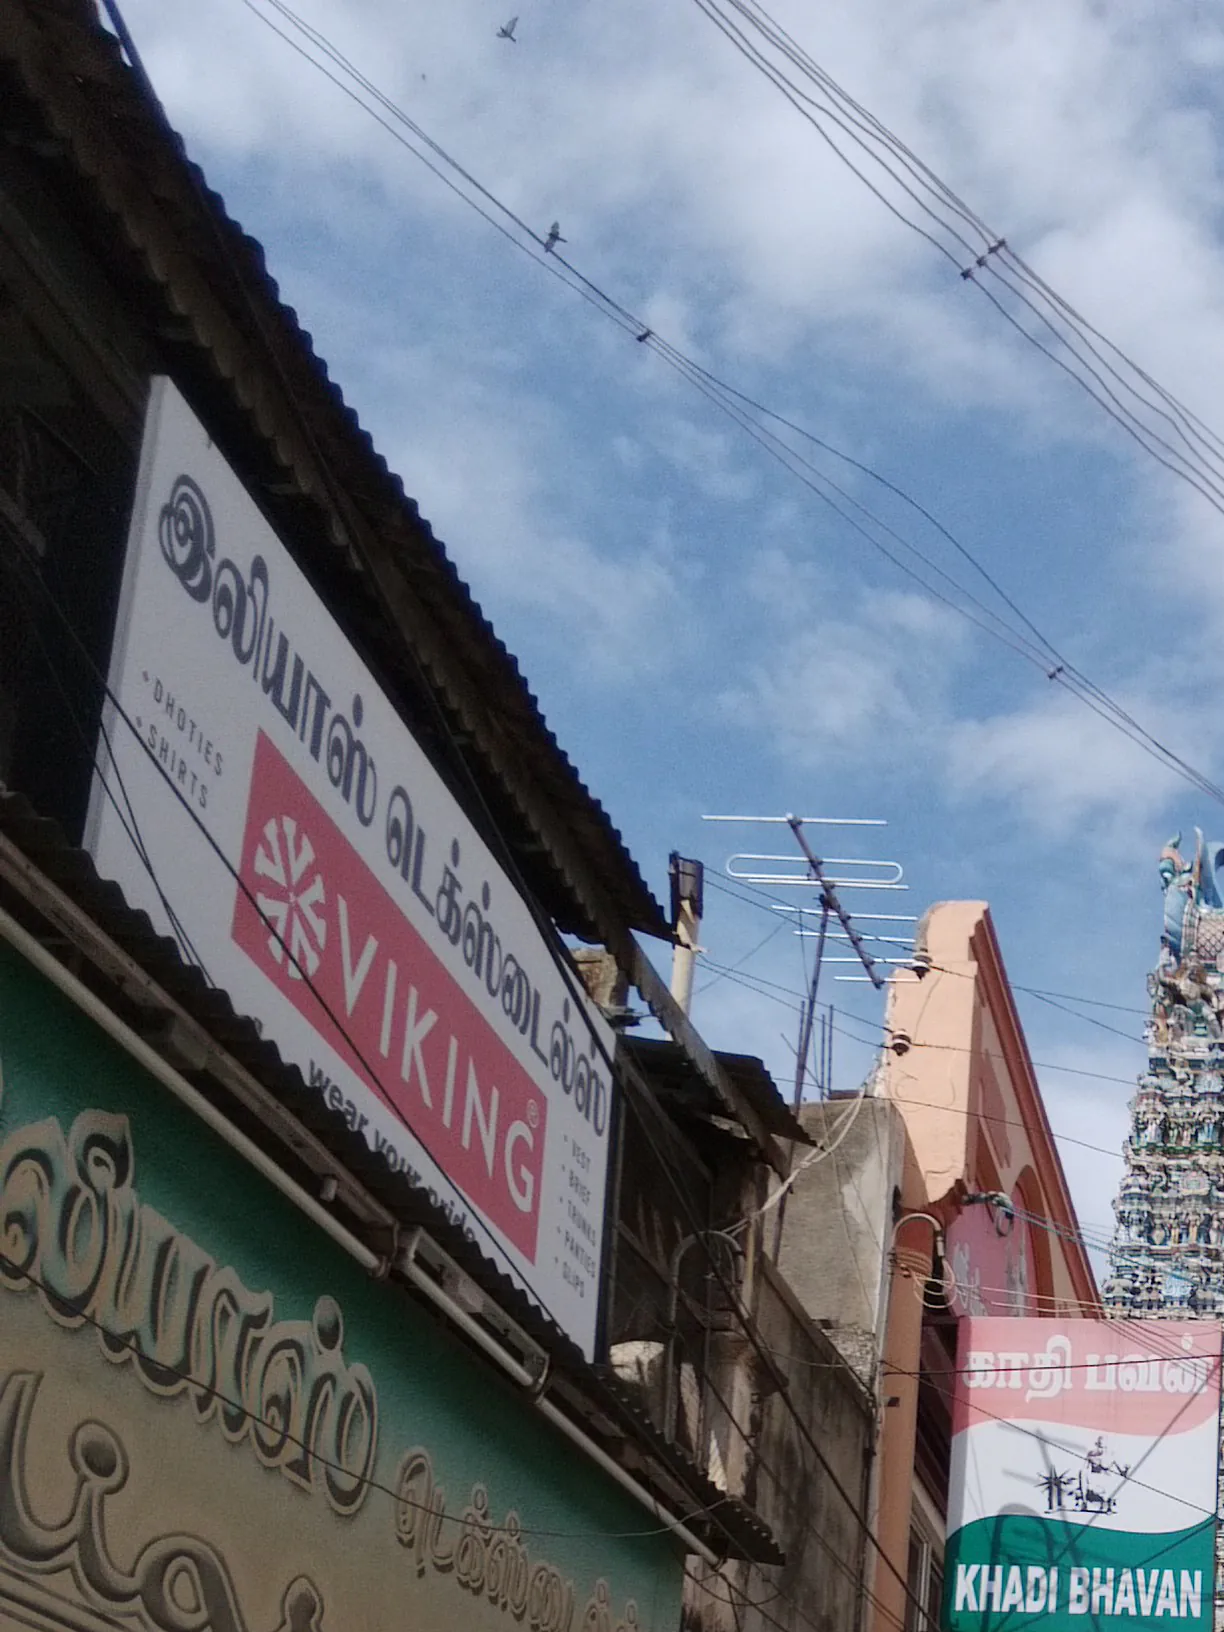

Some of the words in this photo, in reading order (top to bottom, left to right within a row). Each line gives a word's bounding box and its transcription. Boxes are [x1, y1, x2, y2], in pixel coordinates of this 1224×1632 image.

[158, 474, 377, 828] இலியாஸ்
[148, 723, 208, 809] SHIRTS
[154, 676, 224, 777] DHOTIES
[308, 1059, 368, 1132] wear
[336, 893, 537, 1214] VIKING
[962, 1334, 1073, 1403] காதி
[1084, 1332, 1213, 1396] பவன்
[954, 1563, 1059, 1615] KHADI
[1069, 1567, 1204, 1619] BHAVAN
